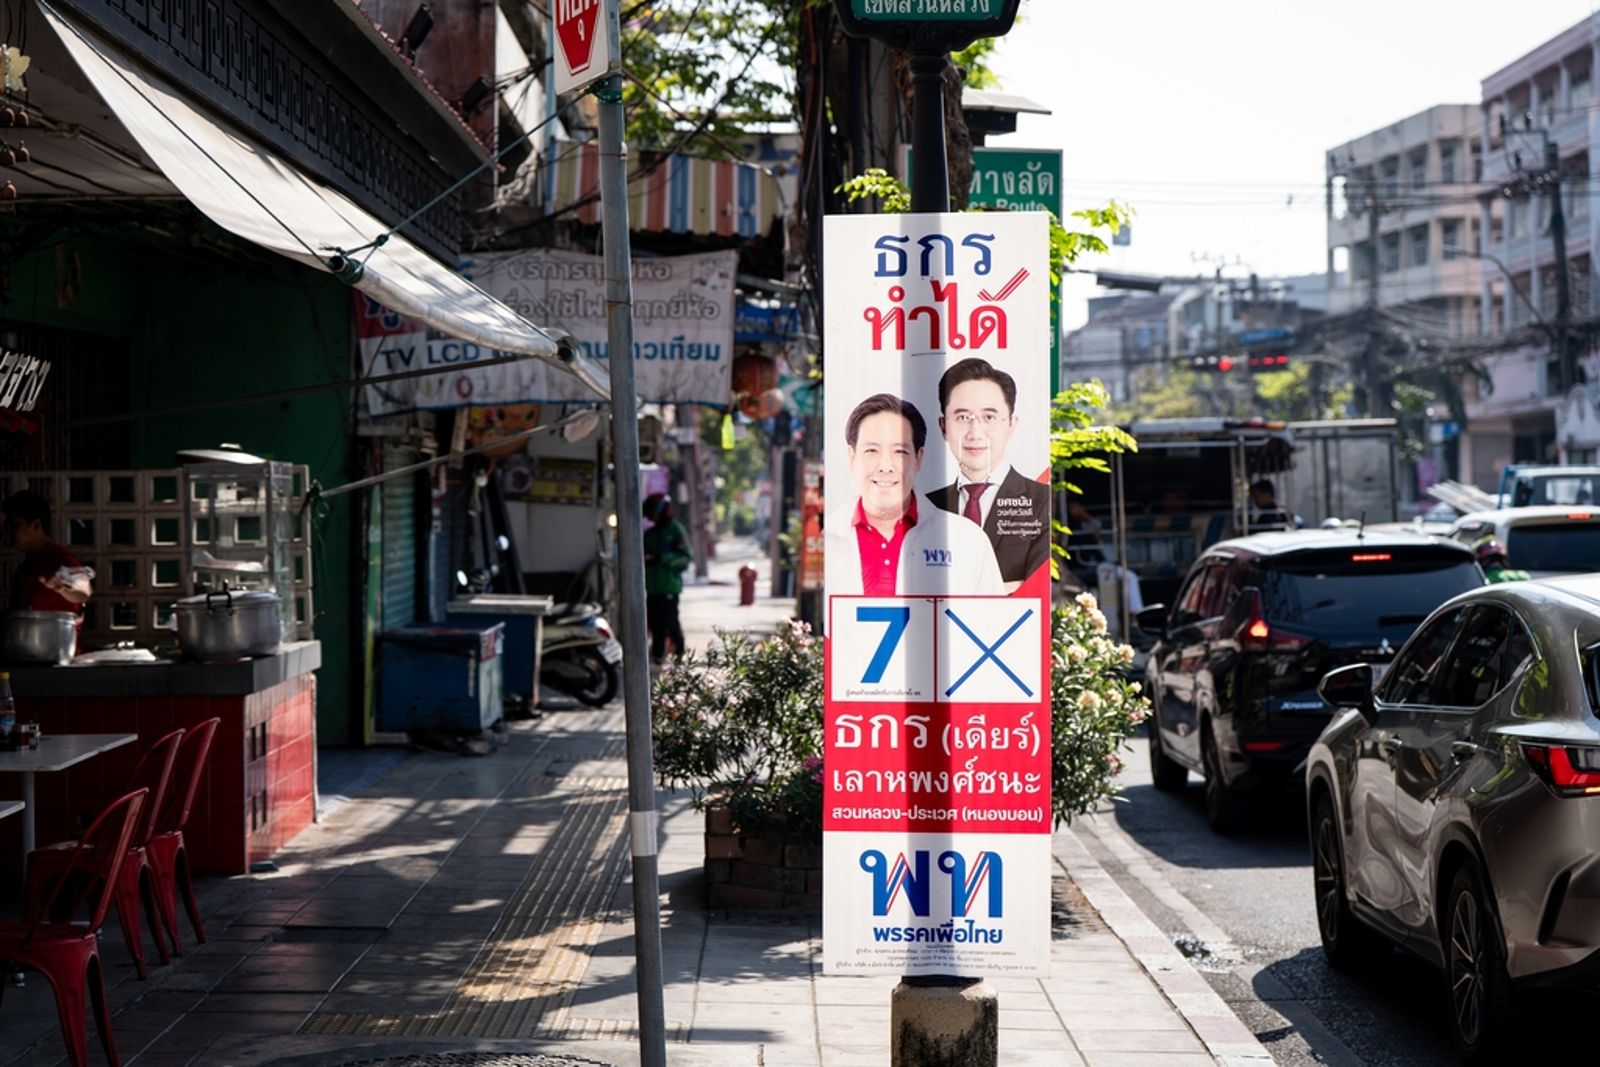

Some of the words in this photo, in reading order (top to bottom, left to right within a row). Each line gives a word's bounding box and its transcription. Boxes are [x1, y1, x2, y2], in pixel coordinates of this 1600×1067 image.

[874, 233, 996, 278] ธกร
[863, 267, 1030, 350] ทำได้
[378, 346, 416, 371] TV
[427, 343, 480, 365] LCD
[855, 606, 911, 684] 7
[834, 713, 931, 749] ธกร
[941, 711, 1041, 757] (เดียร์)
[833, 755, 1041, 794] เลาหพงศ์ชนะ
[832, 805, 959, 821] สวนหลวง-ประเวศ
[962, 806, 1044, 823] (หนองบอน)
[859, 849, 1003, 918] พท
[873, 919, 1004, 944] พรรคเพื่อไทย
